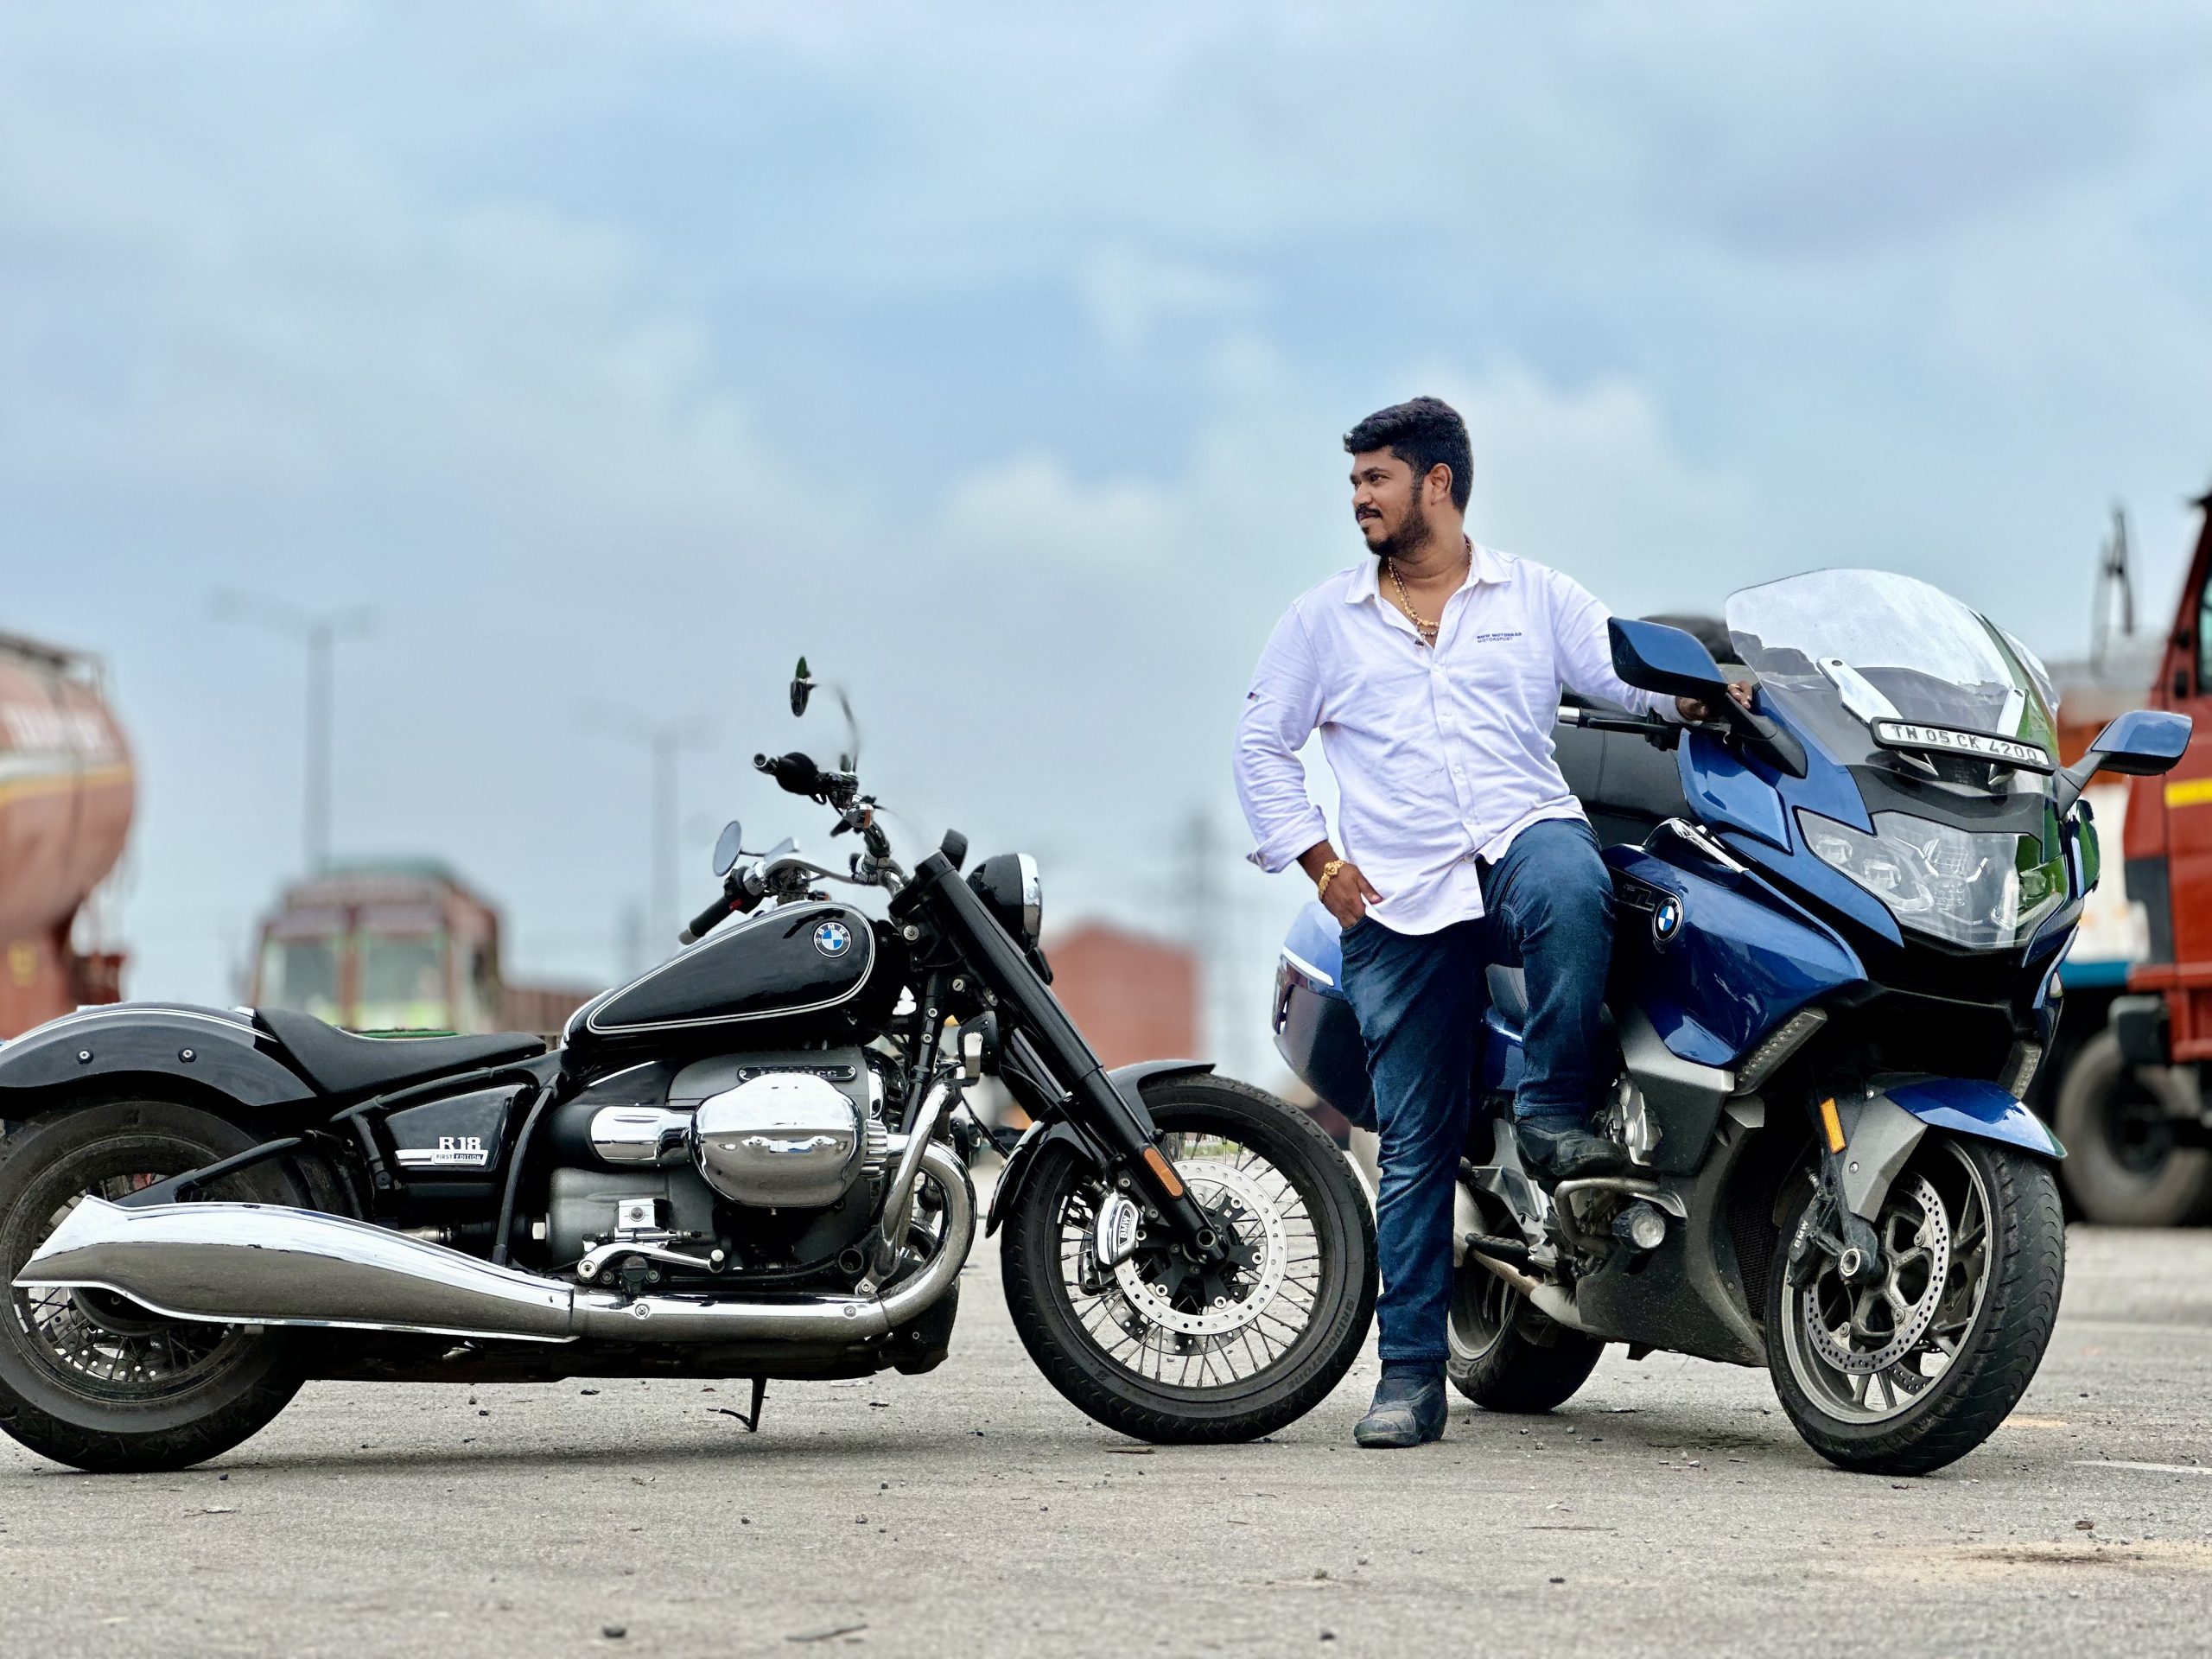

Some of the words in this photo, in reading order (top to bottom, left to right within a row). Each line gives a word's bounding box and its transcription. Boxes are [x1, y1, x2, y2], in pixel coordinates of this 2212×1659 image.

[1892, 725, 1918, 741] TN
[1926, 729, 1950, 743] 05
[1956, 734, 1981, 750] CK
[1989, 741, 2038, 761] 4200
[817, 924, 847, 935] BMW
[1120, 1215, 1130, 1239] BMW
[1794, 1220, 1810, 1248] BMW
